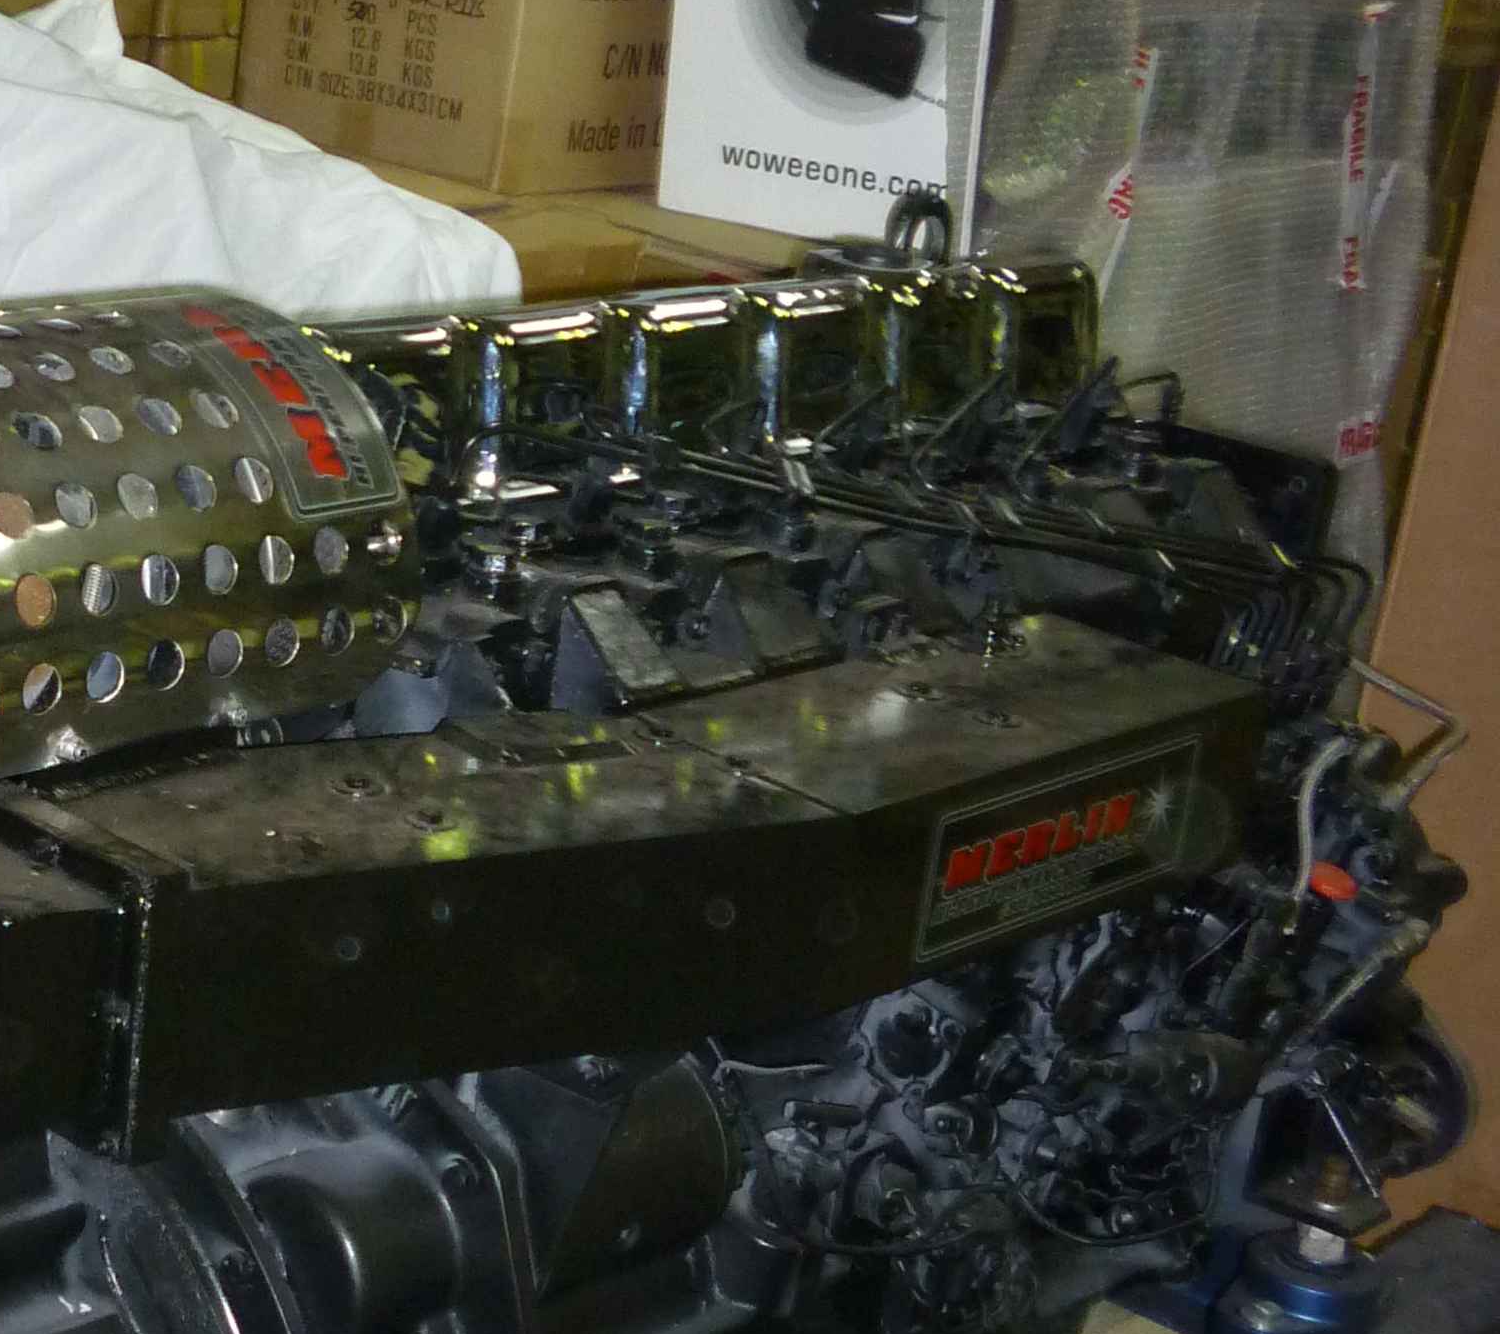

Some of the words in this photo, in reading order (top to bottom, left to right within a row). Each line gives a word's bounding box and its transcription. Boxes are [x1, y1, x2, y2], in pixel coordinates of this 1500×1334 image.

[406, 9, 439, 37] PCS
[403, 37, 437, 63] KGS
[402, 62, 435, 89] KGS
[566, 117, 621, 154] Made
[626, 115, 646, 151] in
